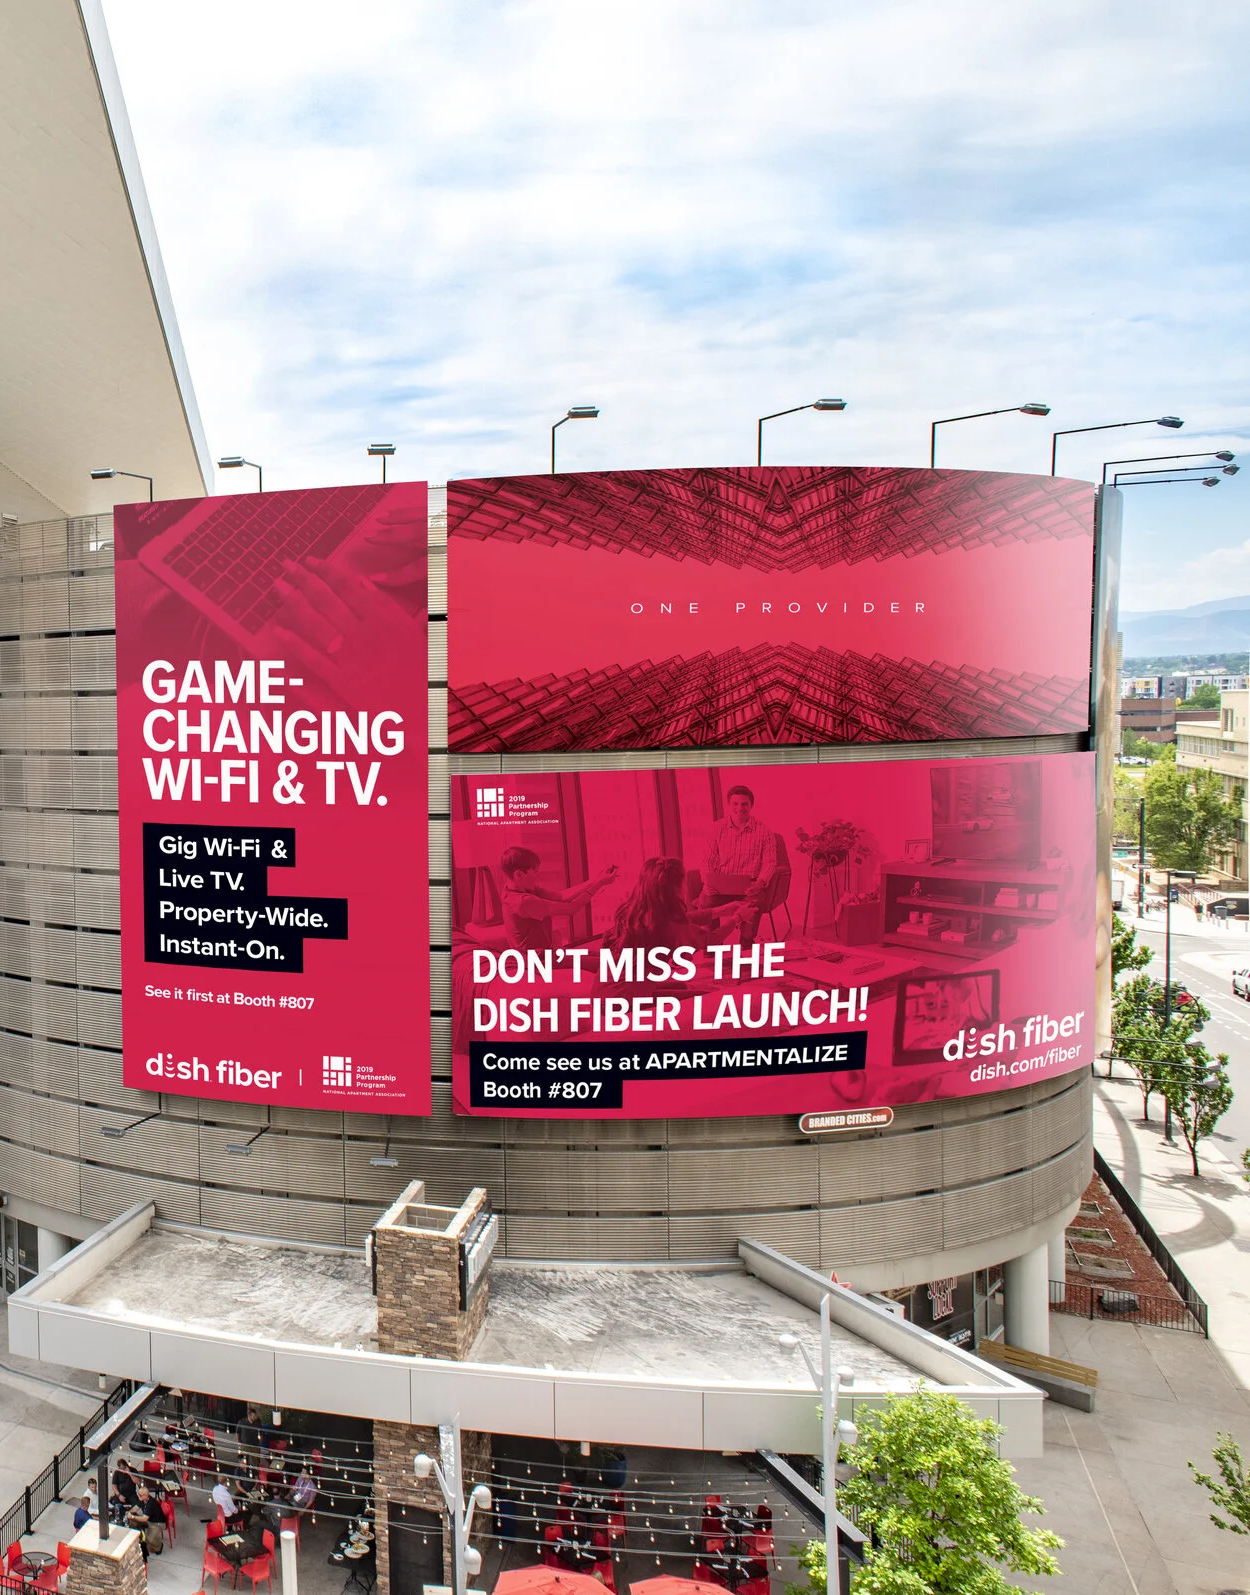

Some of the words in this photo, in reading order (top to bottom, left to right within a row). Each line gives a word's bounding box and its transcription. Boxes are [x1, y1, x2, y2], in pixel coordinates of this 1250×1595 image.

[631, 603, 697, 613] ONE
[736, 603, 924, 613] PROVIDER
[143, 660, 303, 703] GAME-
[143, 709, 404, 755] CHANGING
[142, 758, 258, 802] WI-FI
[273, 760, 305, 804] &
[317, 761, 387, 806] TV.
[160, 836, 196, 859] Gig
[204, 838, 259, 857] Wi-Fi
[272, 840, 287, 858] &
[160, 869, 204, 888] Live
[210, 871, 244, 890] TV.
[160, 901, 328, 929] Property-Wide.
[161, 934, 284, 960] Instant-On.
[600, 946, 696, 982] MISS
[707, 942, 785, 979] THE
[145, 985, 171, 998] See
[175, 988, 183, 999] it
[187, 989, 213, 1002] first
[217, 993, 230, 1004] at
[234, 992, 275, 1007] Booth
[279, 996, 314, 1009] #807
[474, 998, 558, 1032] DISH
[571, 997, 680, 1031] FIBER
[694, 987, 868, 1029] LAUNCH!
[943, 1024, 1015, 1061] dish
[1023, 1011, 1084, 1046] fiber
[146, 1053, 209, 1081] dish
[216, 1060, 282, 1088] fiber
[483, 1053, 540, 1070] Come
[547, 1058, 581, 1070] see
[589, 1058, 612, 1070] us
[619, 1055, 640, 1070] at
[646, 1045, 847, 1069] APARTMENTALIZE
[970, 1044, 1082, 1082] dish.com/fiber
[356, 1074, 396, 1082] Partnership
[484, 1082, 540, 1098] Booth
[548, 1082, 602, 1098] #807
[809, 1116, 845, 1128] BRANDED
[847, 1113, 886, 1125] CITIES.com
